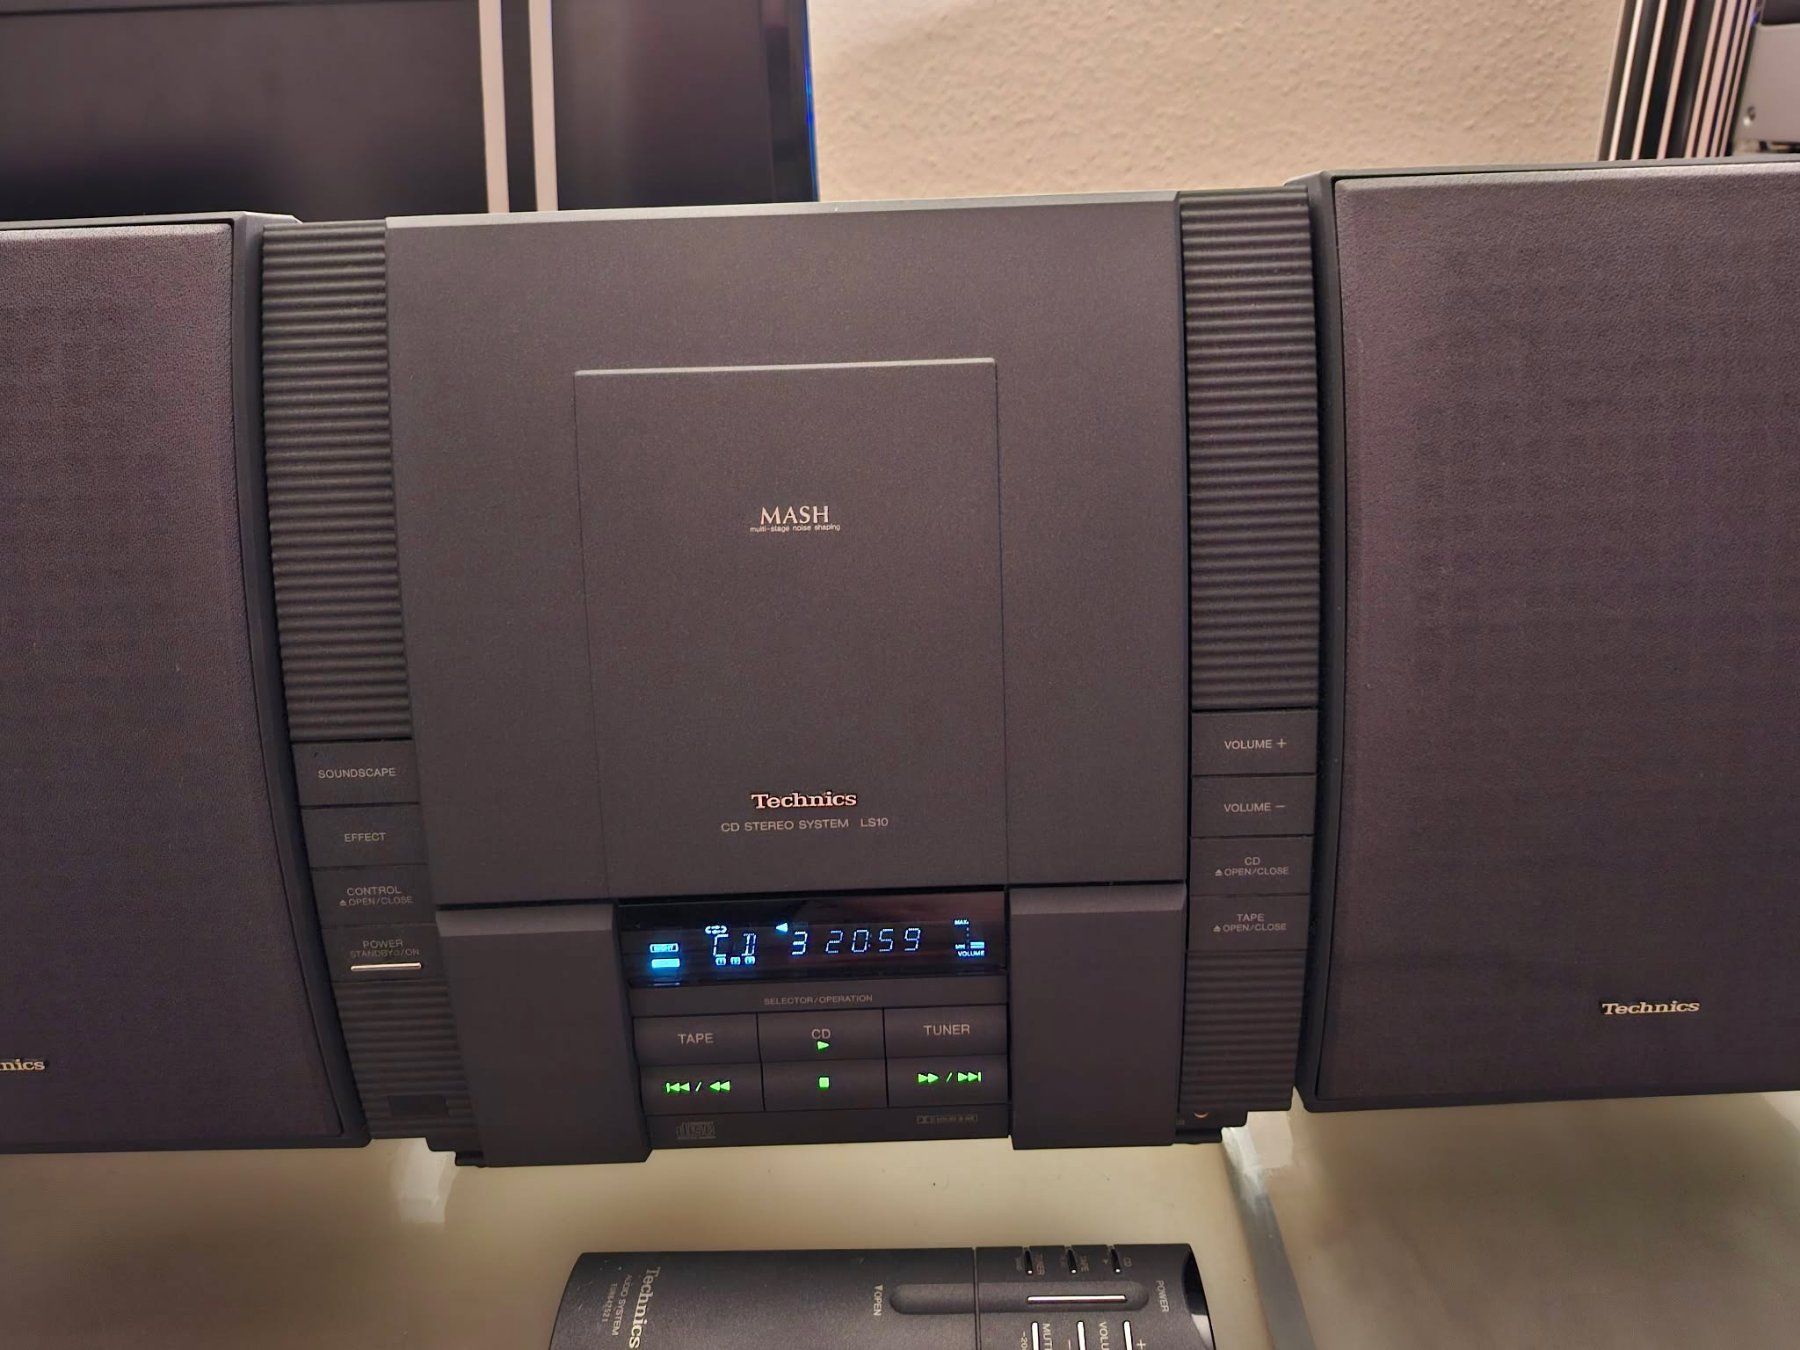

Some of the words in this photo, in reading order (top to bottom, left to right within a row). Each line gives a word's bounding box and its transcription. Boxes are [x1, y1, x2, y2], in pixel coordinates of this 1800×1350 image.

[760, 505, 829, 524] MASH
[750, 525, 790, 533] multi-stage
[814, 523, 841, 532] shaping
[1224, 739, 1272, 750] VOLUME
[318, 767, 397, 779] SOUNDSCAPE
[751, 791, 857, 809] Technics
[1223, 802, 1271, 813] VOLUME
[721, 822, 740, 832] CD
[744, 820, 795, 831] STEREO
[798, 818, 849, 830] SYSTEM
[860, 817, 889, 828] LS10
[344, 832, 386, 842] EFFECT
[1244, 857, 1261, 866] CD
[1224, 866, 1289, 877] OPEN/CLOSE
[346, 886, 402, 896] CONTROL
[348, 895, 413, 906] OPEN/CLOSE
[1236, 913, 1265, 923] TAPE
[1222, 922, 1287, 933] OPEN/CLOSE
[362, 939, 403, 949] POWER
[791, 931, 808, 956] 3
[763, 994, 873, 1006] SELECTOR/OPERATION
[1601, 1001, 1700, 1015] Technics
[811, 1028, 831, 1040] CD
[923, 1023, 971, 1037] TUNER
[677, 1033, 714, 1044] TAPE
[0, 1058, 46, 1071] nics
[1155, 1280, 1170, 1313] POWER
[628, 1266, 661, 1349] Technics
[873, 1291, 883, 1316] OPEN
[612, 1298, 627, 1336] SYSTEM
